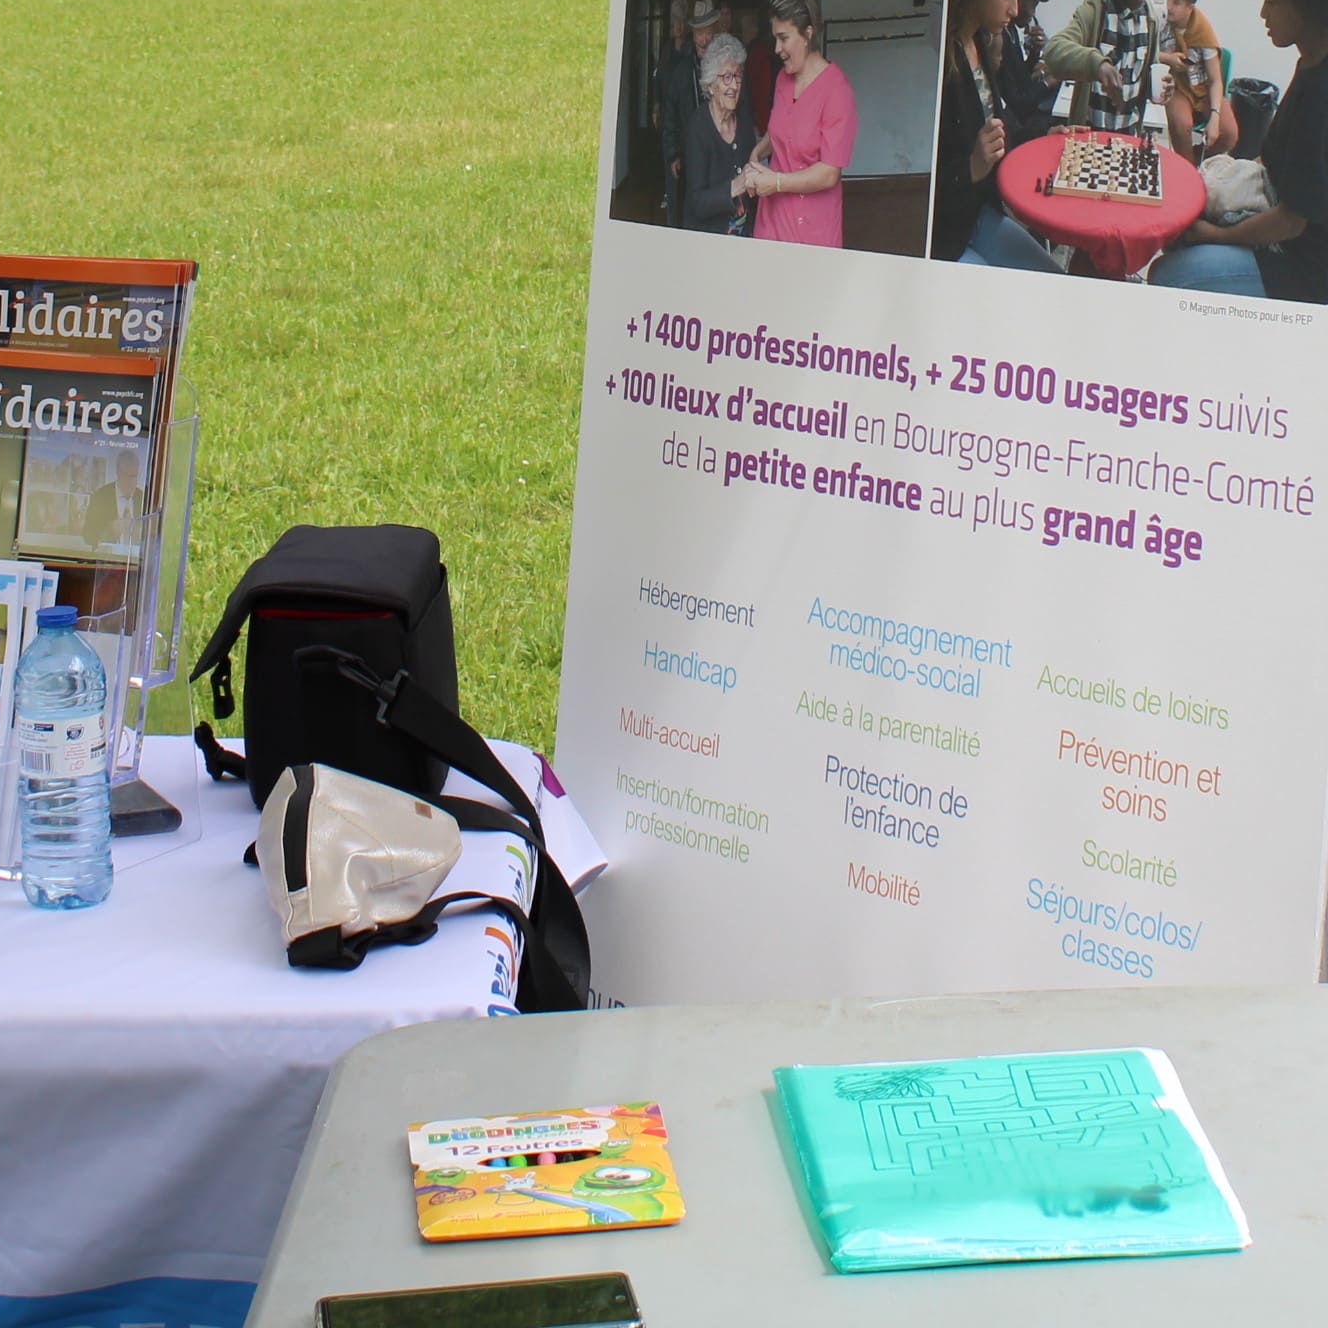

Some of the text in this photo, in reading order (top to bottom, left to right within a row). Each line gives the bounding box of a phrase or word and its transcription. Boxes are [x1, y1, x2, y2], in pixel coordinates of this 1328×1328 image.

[1190, 302, 1226, 317] Magnum
[1229, 305, 1258, 320] Photos
[1260, 312, 1280, 321] pour
[1281, 312, 1293, 323] les
[1296, 313, 1312, 325] PEP
[642, 310, 702, 352] 1400
[707, 325, 918, 391] professionnels,
[949, 354, 988, 395] 25
[993, 360, 1057, 406] 000
[1063, 376, 1190, 429] usagers
[1198, 393, 1288, 440] suivis
[622, 368, 656, 407] 100
[660, 373, 721, 418] lieux
[854, 415, 885, 446] en
[894, 411, 1313, 515] Bourgogne-Franche-Comté
[662, 431, 1204, 569] de la petite enfance au plus grand âge
[638, 577, 756, 628] Hébergement
[807, 596, 1013, 671] Accompagnement
[644, 640, 736, 694] Handicap
[829, 642, 981, 698] médico-social
[796, 690, 981, 757] Aide à la parentalité
[1037, 665, 1228, 729] Accueils de loisirs
[619, 707, 720, 758] Multi-accueil
[825, 754, 969, 819] Protection de
[1058, 729, 1222, 796] Prévention et
[616, 767, 769, 833] Insertion/formation
[1102, 785, 1168, 822] soins
[625, 810, 750, 863] professionnelle
[1082, 839, 1177, 887] Scolarité
[847, 862, 921, 907] Mobilité
[1026, 878, 1202, 951] Séjours/colos/
[1062, 929, 1153, 979] classes
[444, 1137, 584, 1156] 12 Feutres
